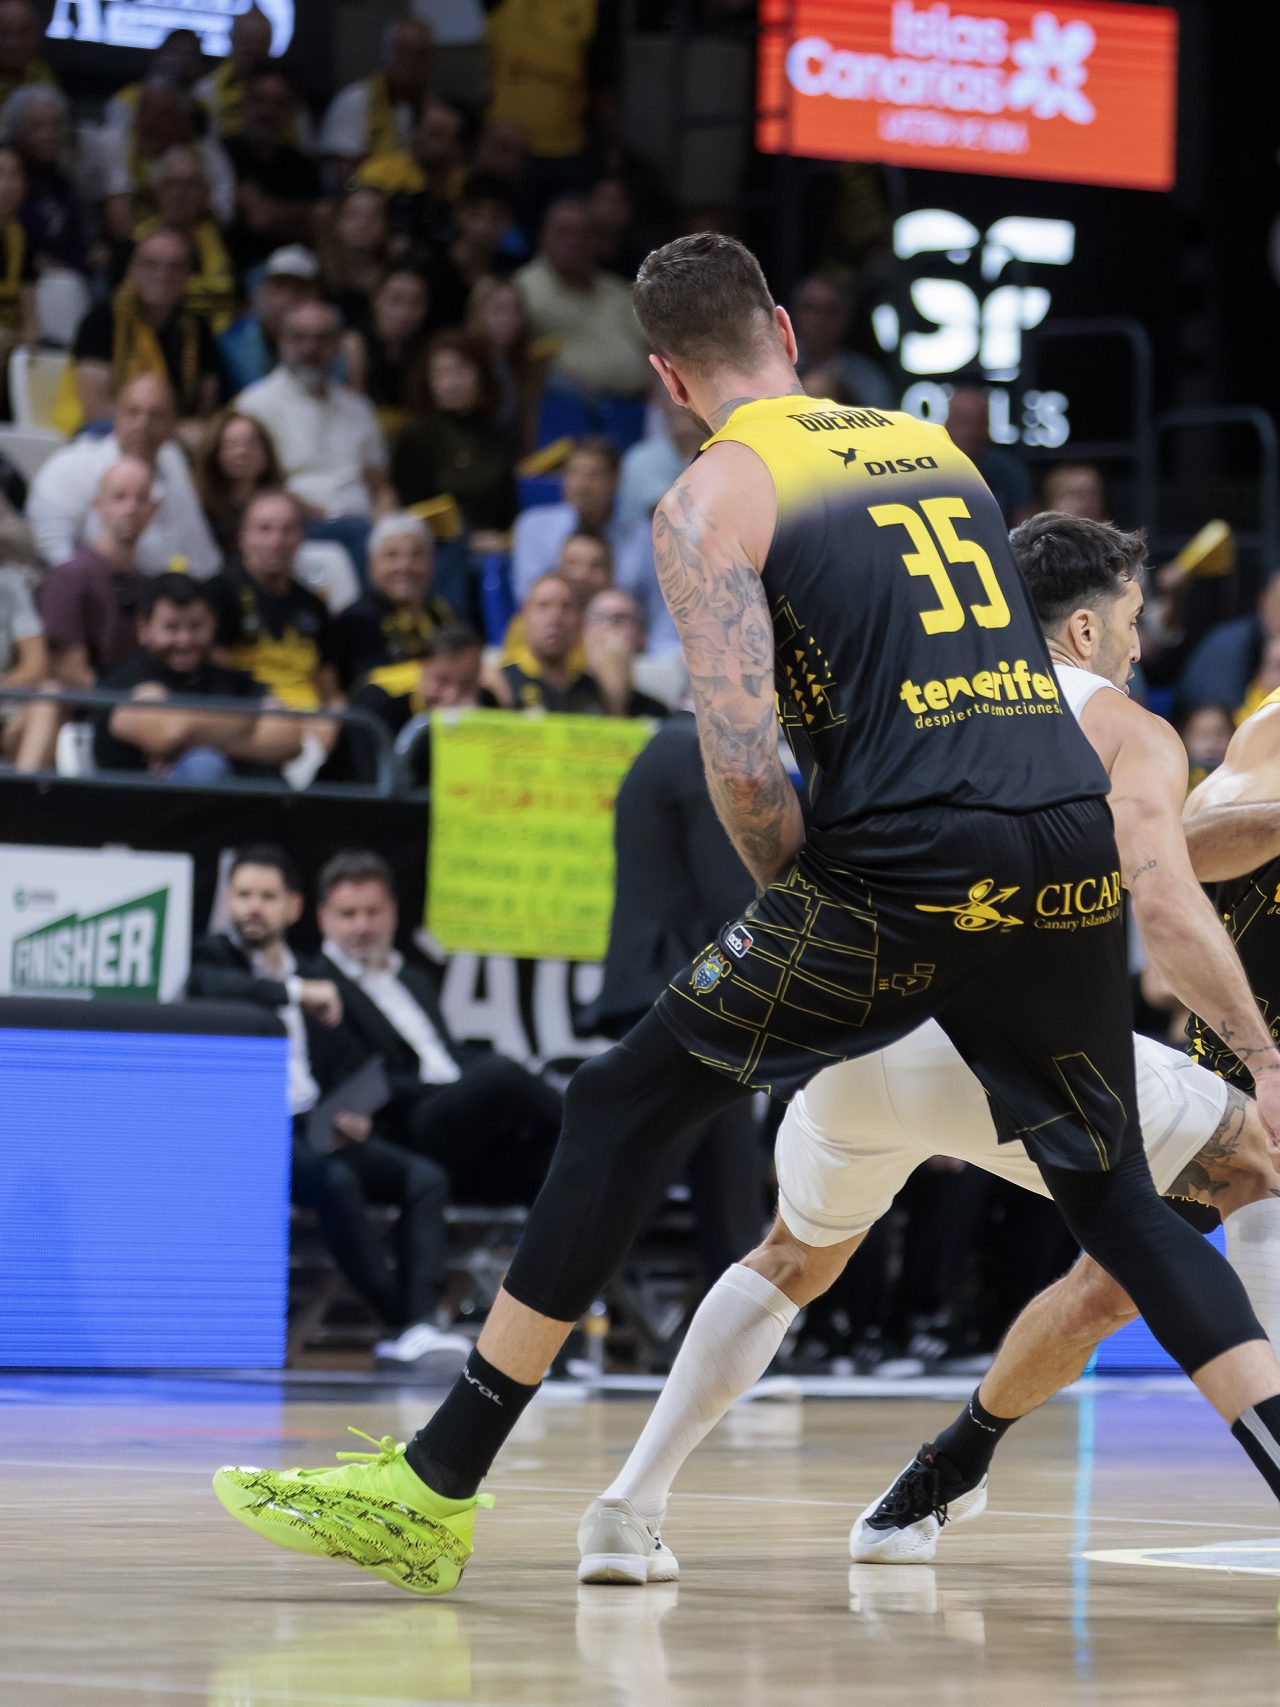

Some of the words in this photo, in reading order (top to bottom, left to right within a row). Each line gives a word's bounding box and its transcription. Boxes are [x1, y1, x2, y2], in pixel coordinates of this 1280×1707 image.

[786, 409, 895, 432] GUERRA
[867, 497, 1012, 636] 35
[914, 702, 990, 730] despierta
[1036, 871, 1121, 917] CICAR
[1033, 917, 1079, 932] Canary
